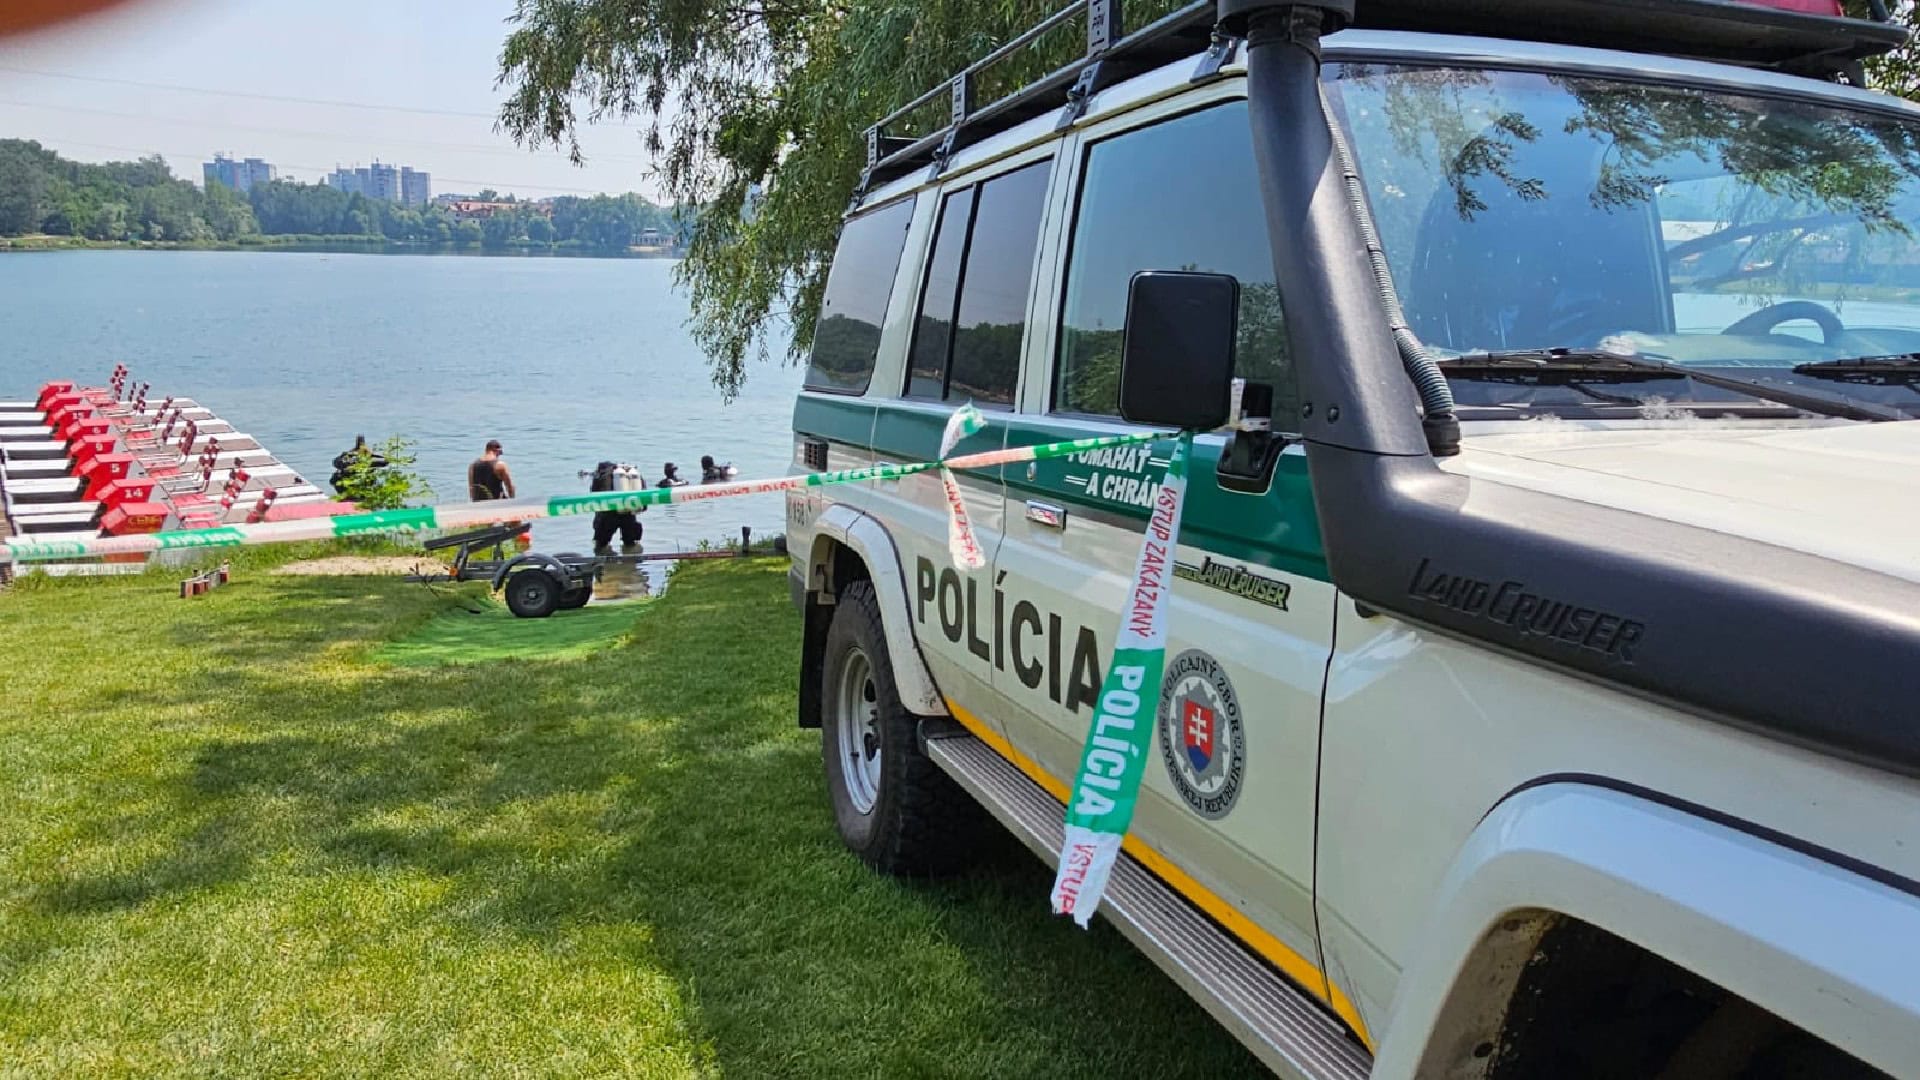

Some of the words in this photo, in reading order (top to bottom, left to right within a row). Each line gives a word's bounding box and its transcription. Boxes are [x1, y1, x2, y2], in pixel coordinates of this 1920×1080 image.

[1086, 472, 1099, 496] A
[1102, 475, 1163, 508] CHRÁN
[1150, 486, 1177, 541] VSTUP
[1127, 541, 1168, 639] ZAKÁZANÝ
[917, 555, 1101, 714] POLÍCIA
[1074, 664, 1146, 817] POLÍCIA
[1056, 843, 1098, 915] VSTUP
